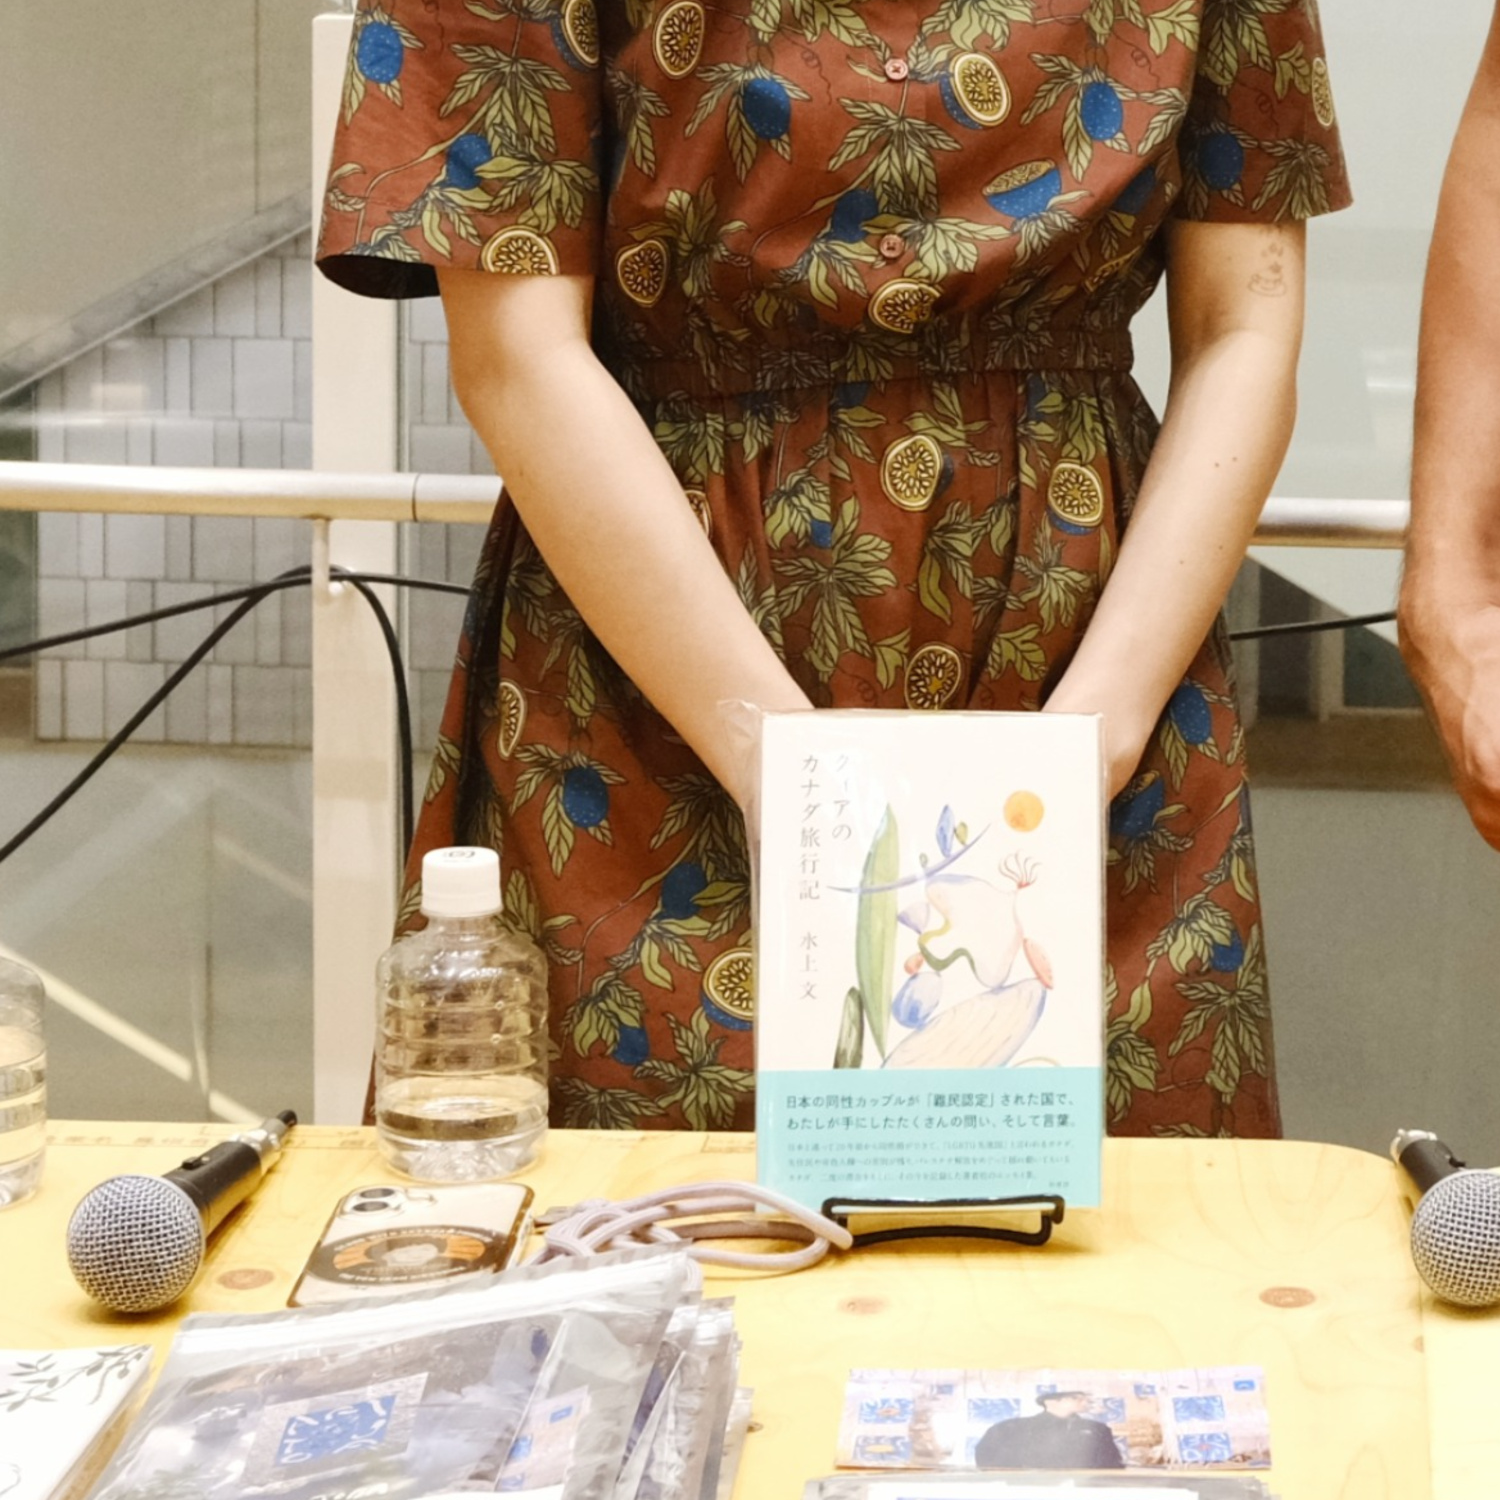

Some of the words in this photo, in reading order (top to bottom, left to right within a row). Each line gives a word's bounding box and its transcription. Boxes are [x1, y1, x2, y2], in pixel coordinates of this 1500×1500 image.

[799, 754, 821, 901] カナダ旅行記
[799, 931, 819, 1001] 水上文
